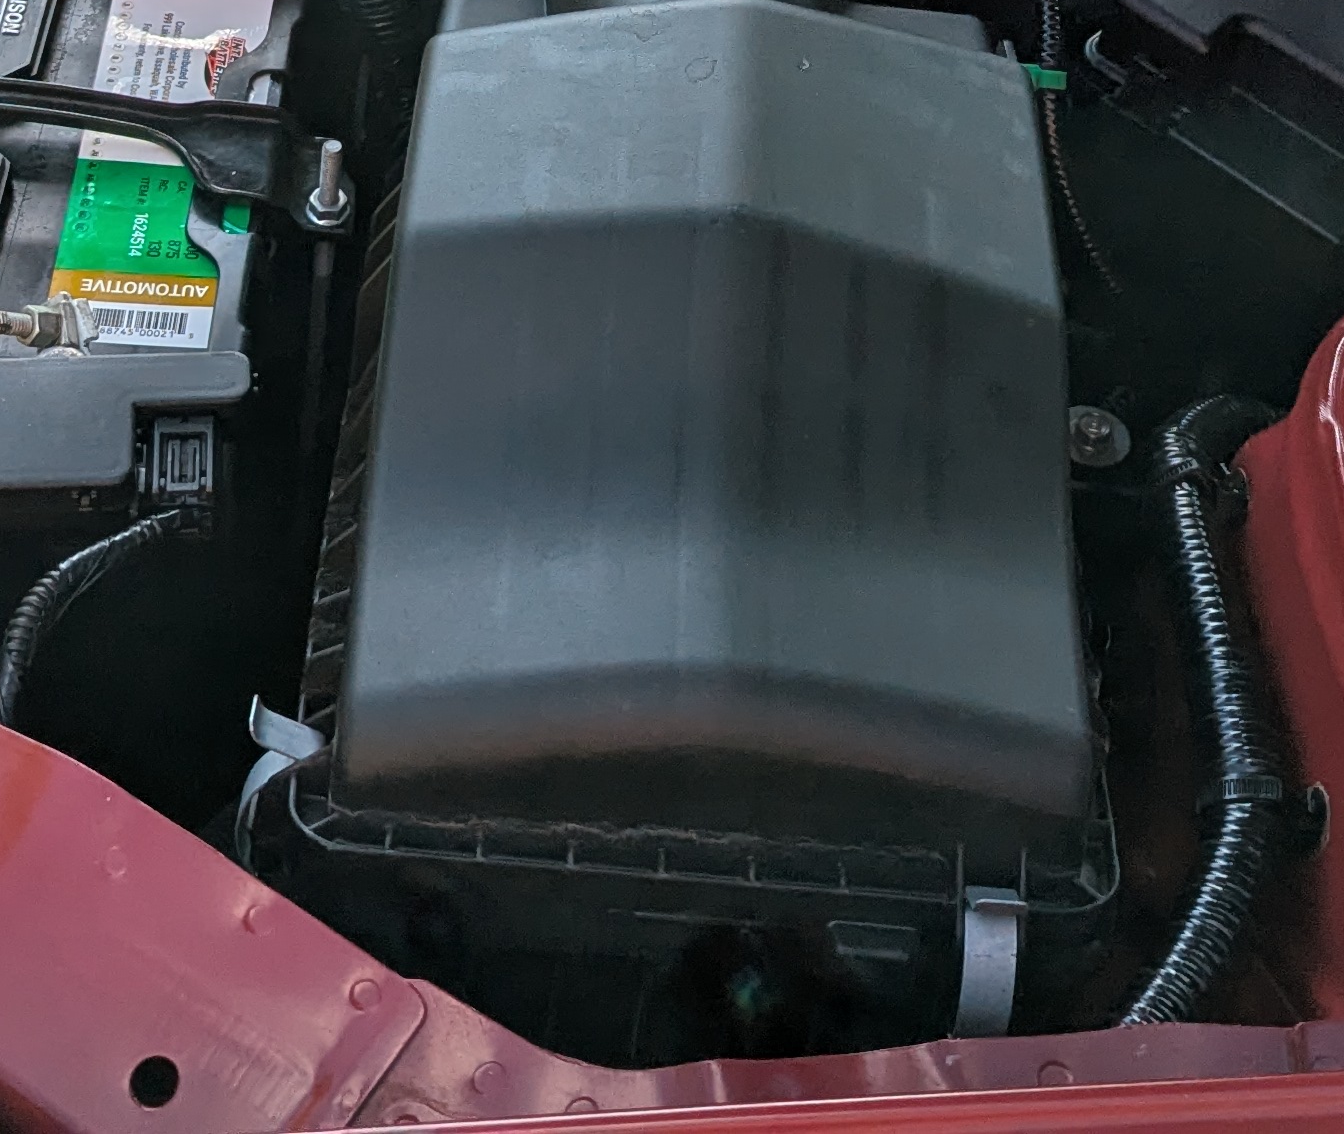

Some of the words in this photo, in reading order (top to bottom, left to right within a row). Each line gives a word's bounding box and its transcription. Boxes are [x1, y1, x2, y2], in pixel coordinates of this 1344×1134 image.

[178, 48, 193, 79] istributed
[138, 176, 151, 196] ITEM
[128, 213, 149, 257] 1624514
[146, 240, 162, 258] 130
[165, 240, 182, 259] 875
[80, 278, 209, 298] AUTOMOTIVE
